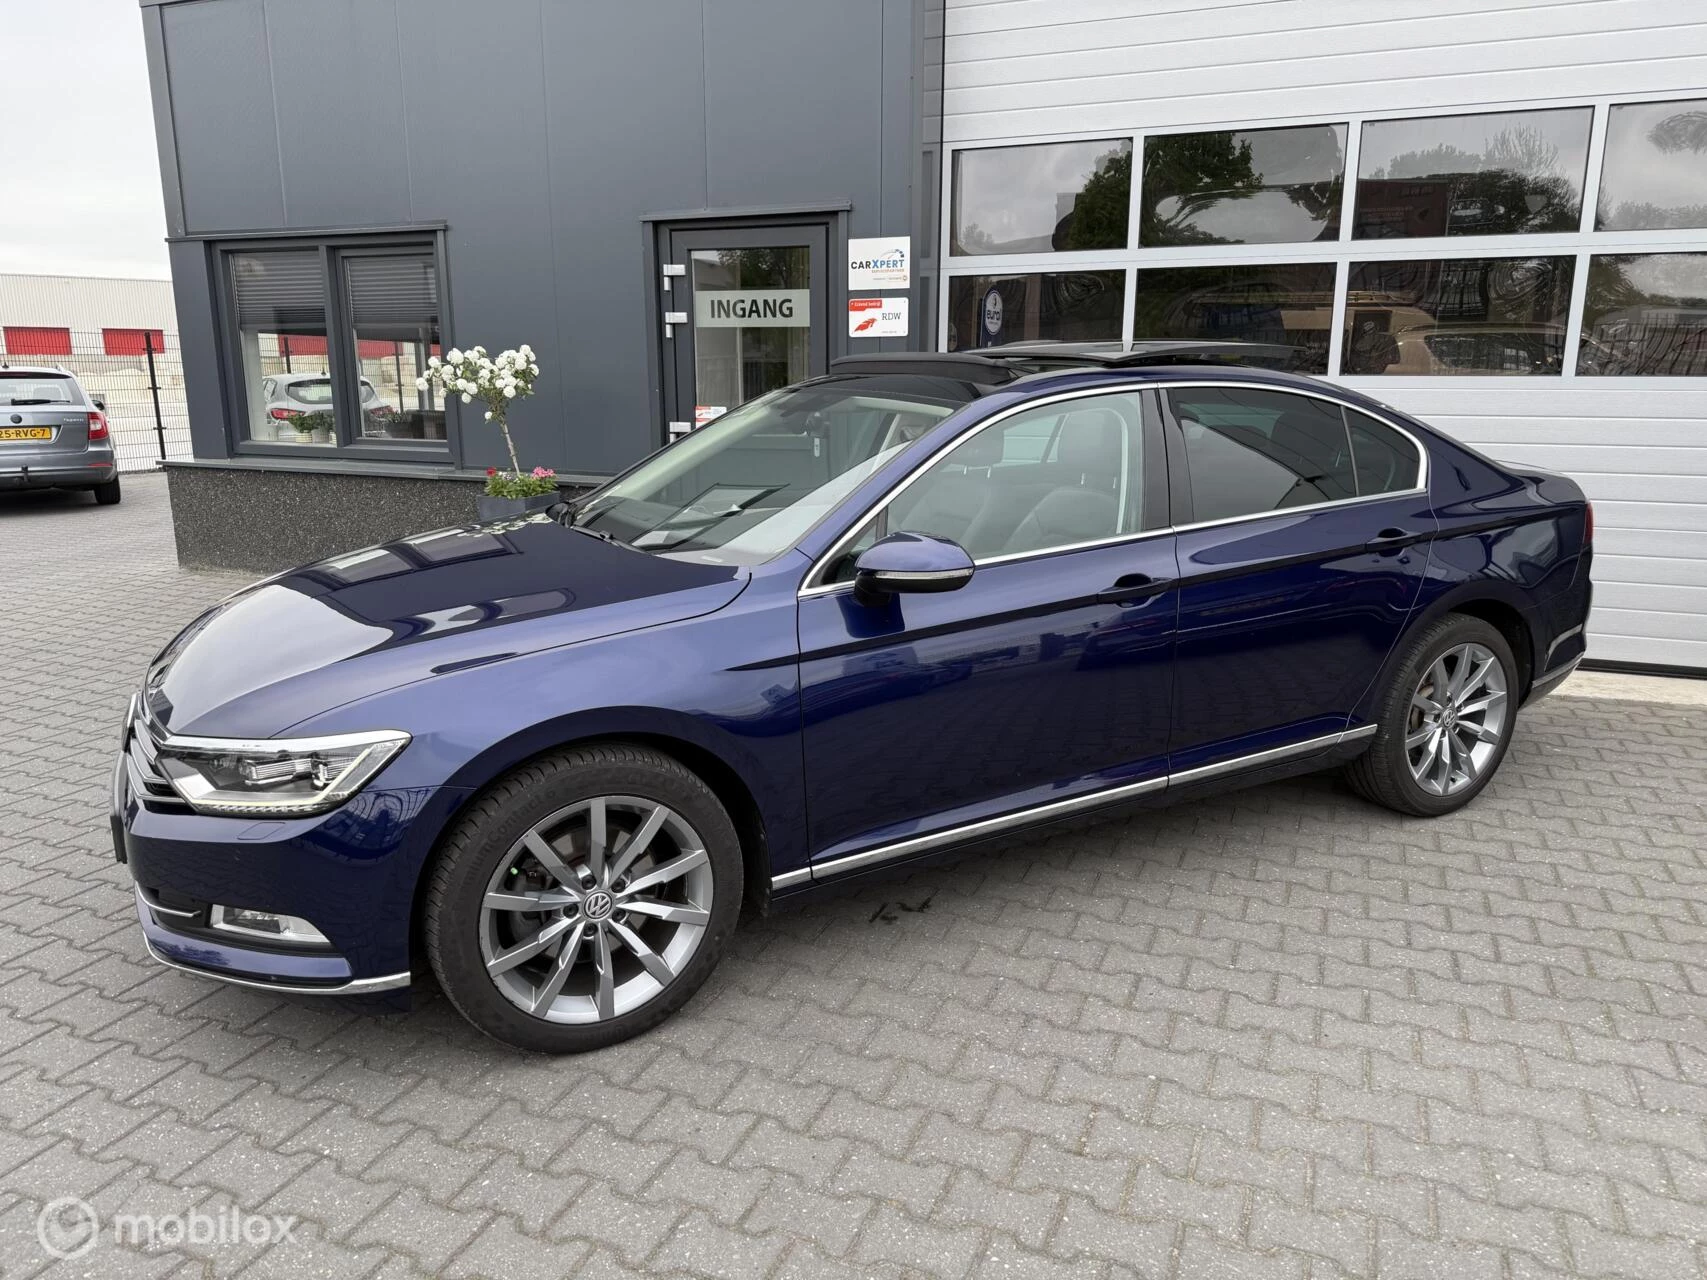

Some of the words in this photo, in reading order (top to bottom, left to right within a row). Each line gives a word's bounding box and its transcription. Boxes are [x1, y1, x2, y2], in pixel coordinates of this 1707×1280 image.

[850, 259, 905, 270] CARXPERT
[710, 298, 793, 319] INGANG
[881, 312, 901, 321] RDW
